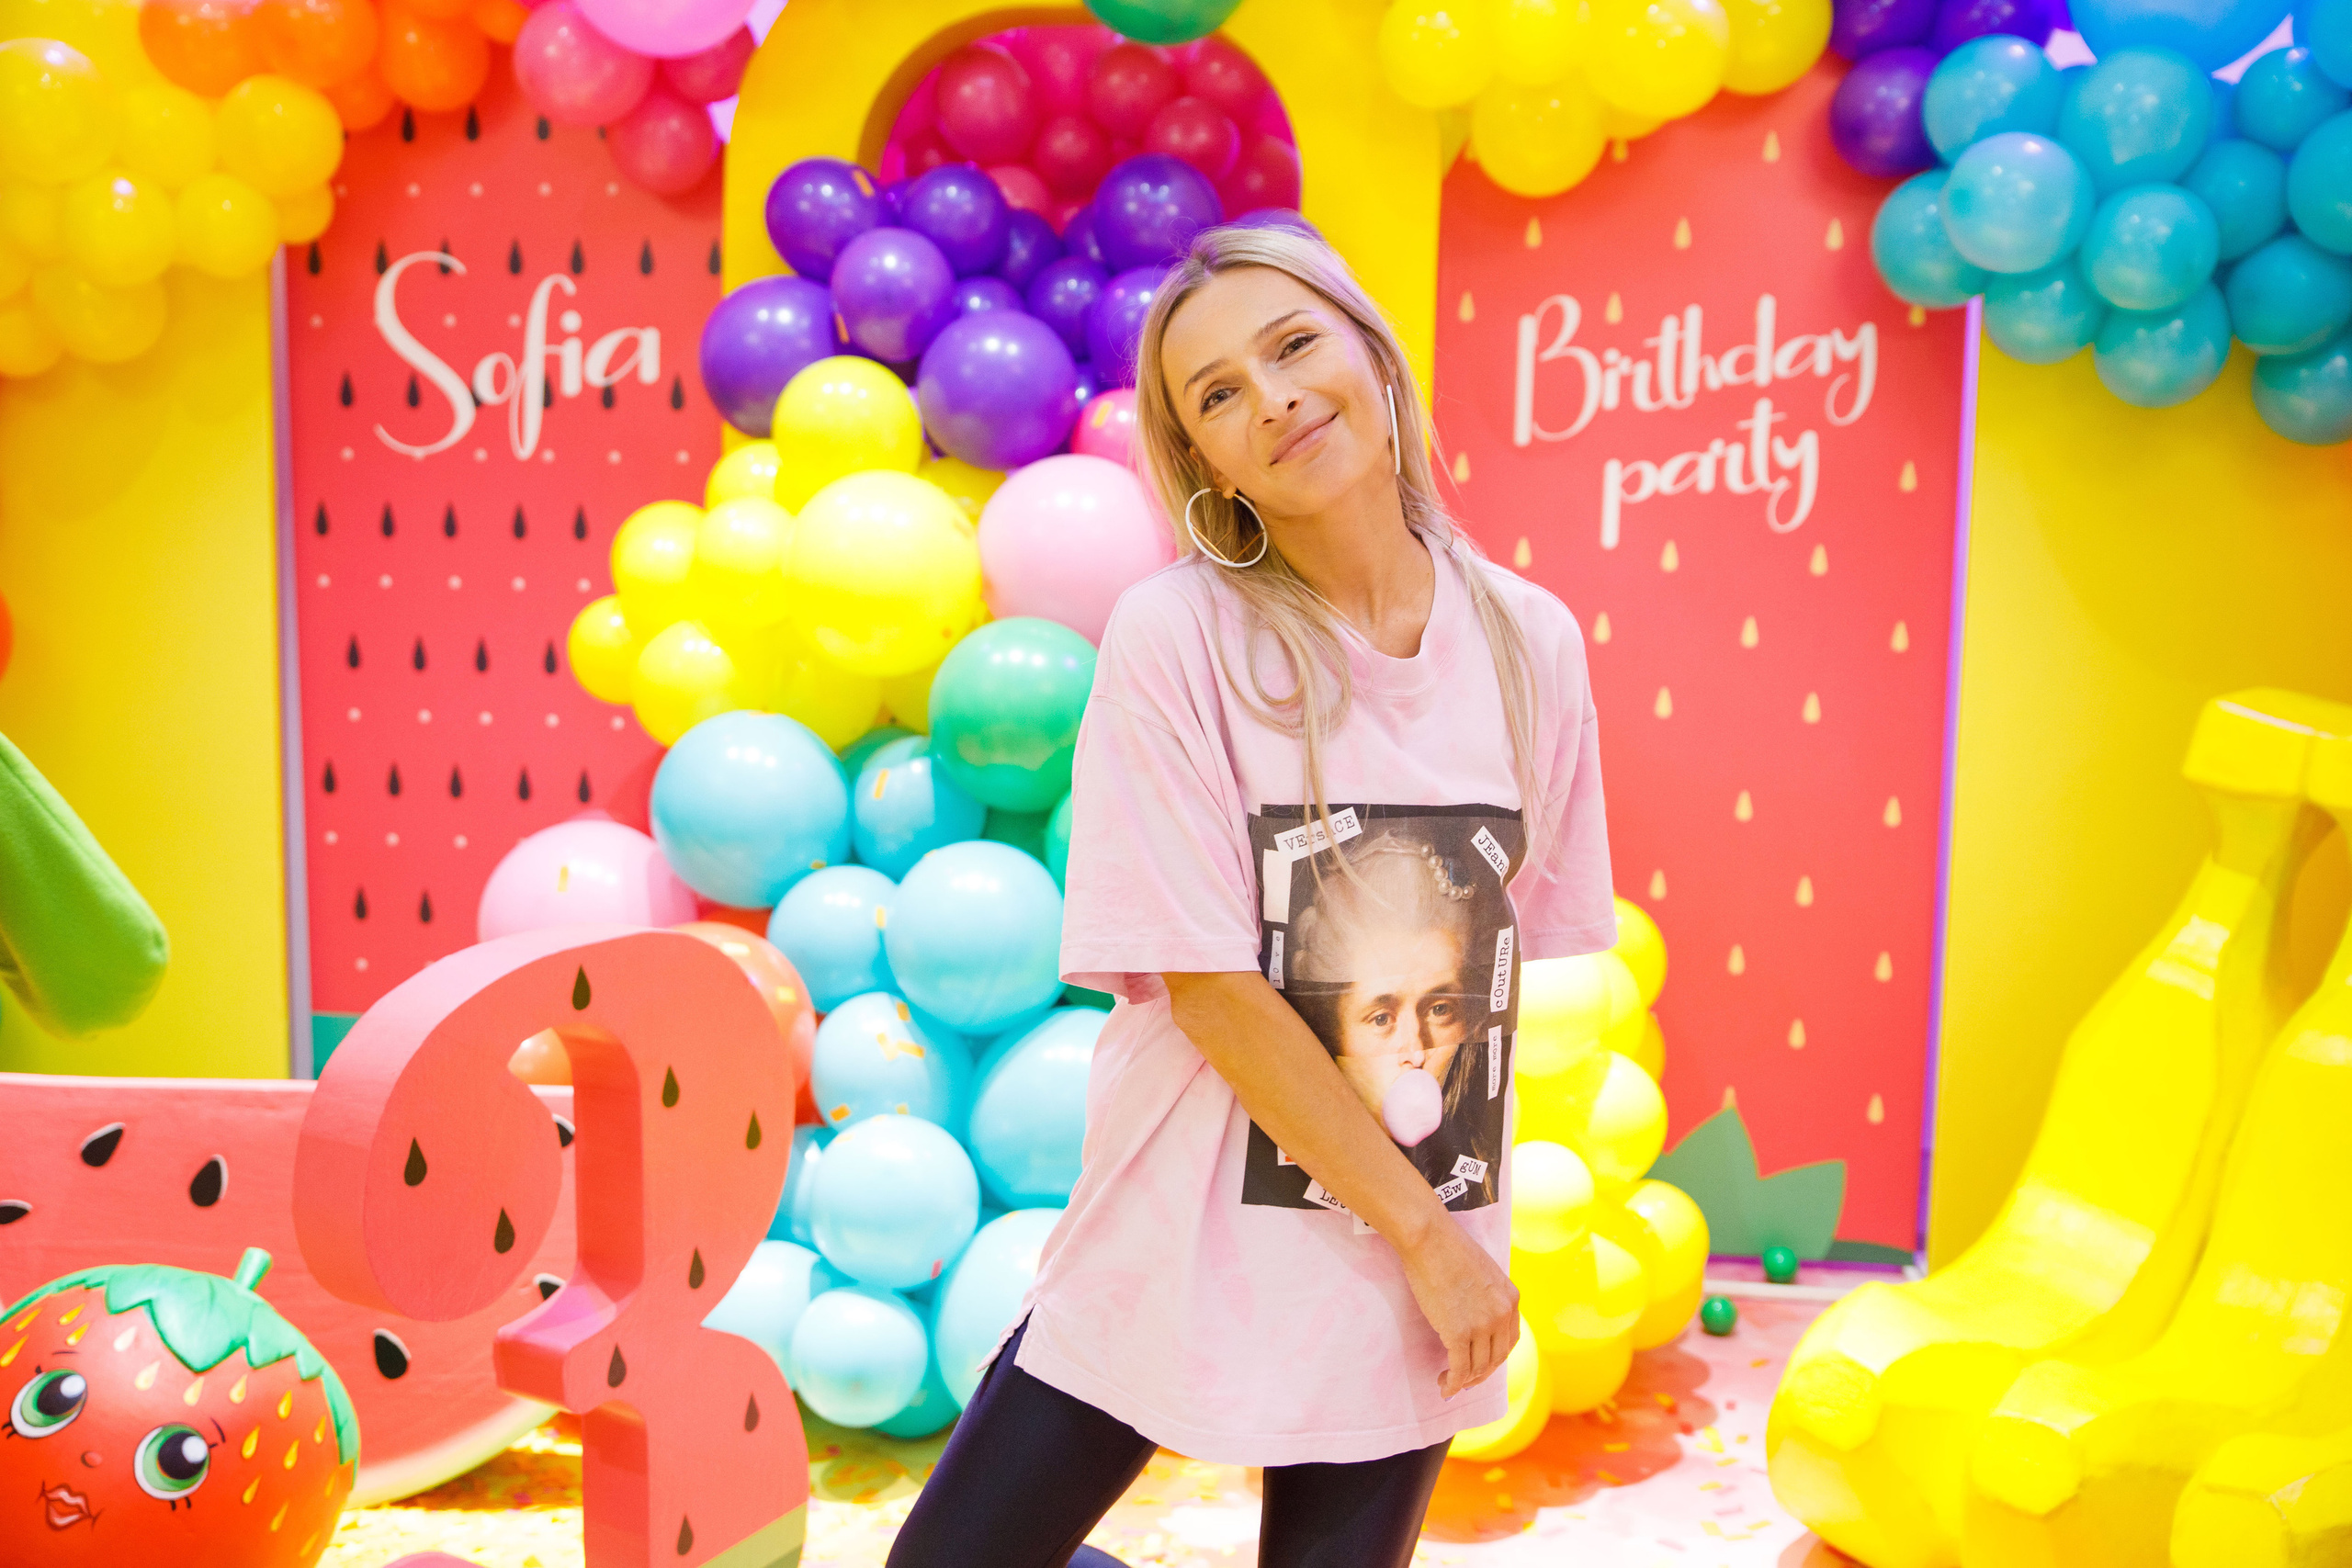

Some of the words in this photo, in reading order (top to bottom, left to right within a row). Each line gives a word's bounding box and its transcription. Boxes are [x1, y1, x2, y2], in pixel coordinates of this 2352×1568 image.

[373, 250, 661, 461] Sofia
[1513, 293, 1878, 447] Birthday
[1600, 397, 1819, 550] party
[1283, 815, 1355, 851] VErsCE
